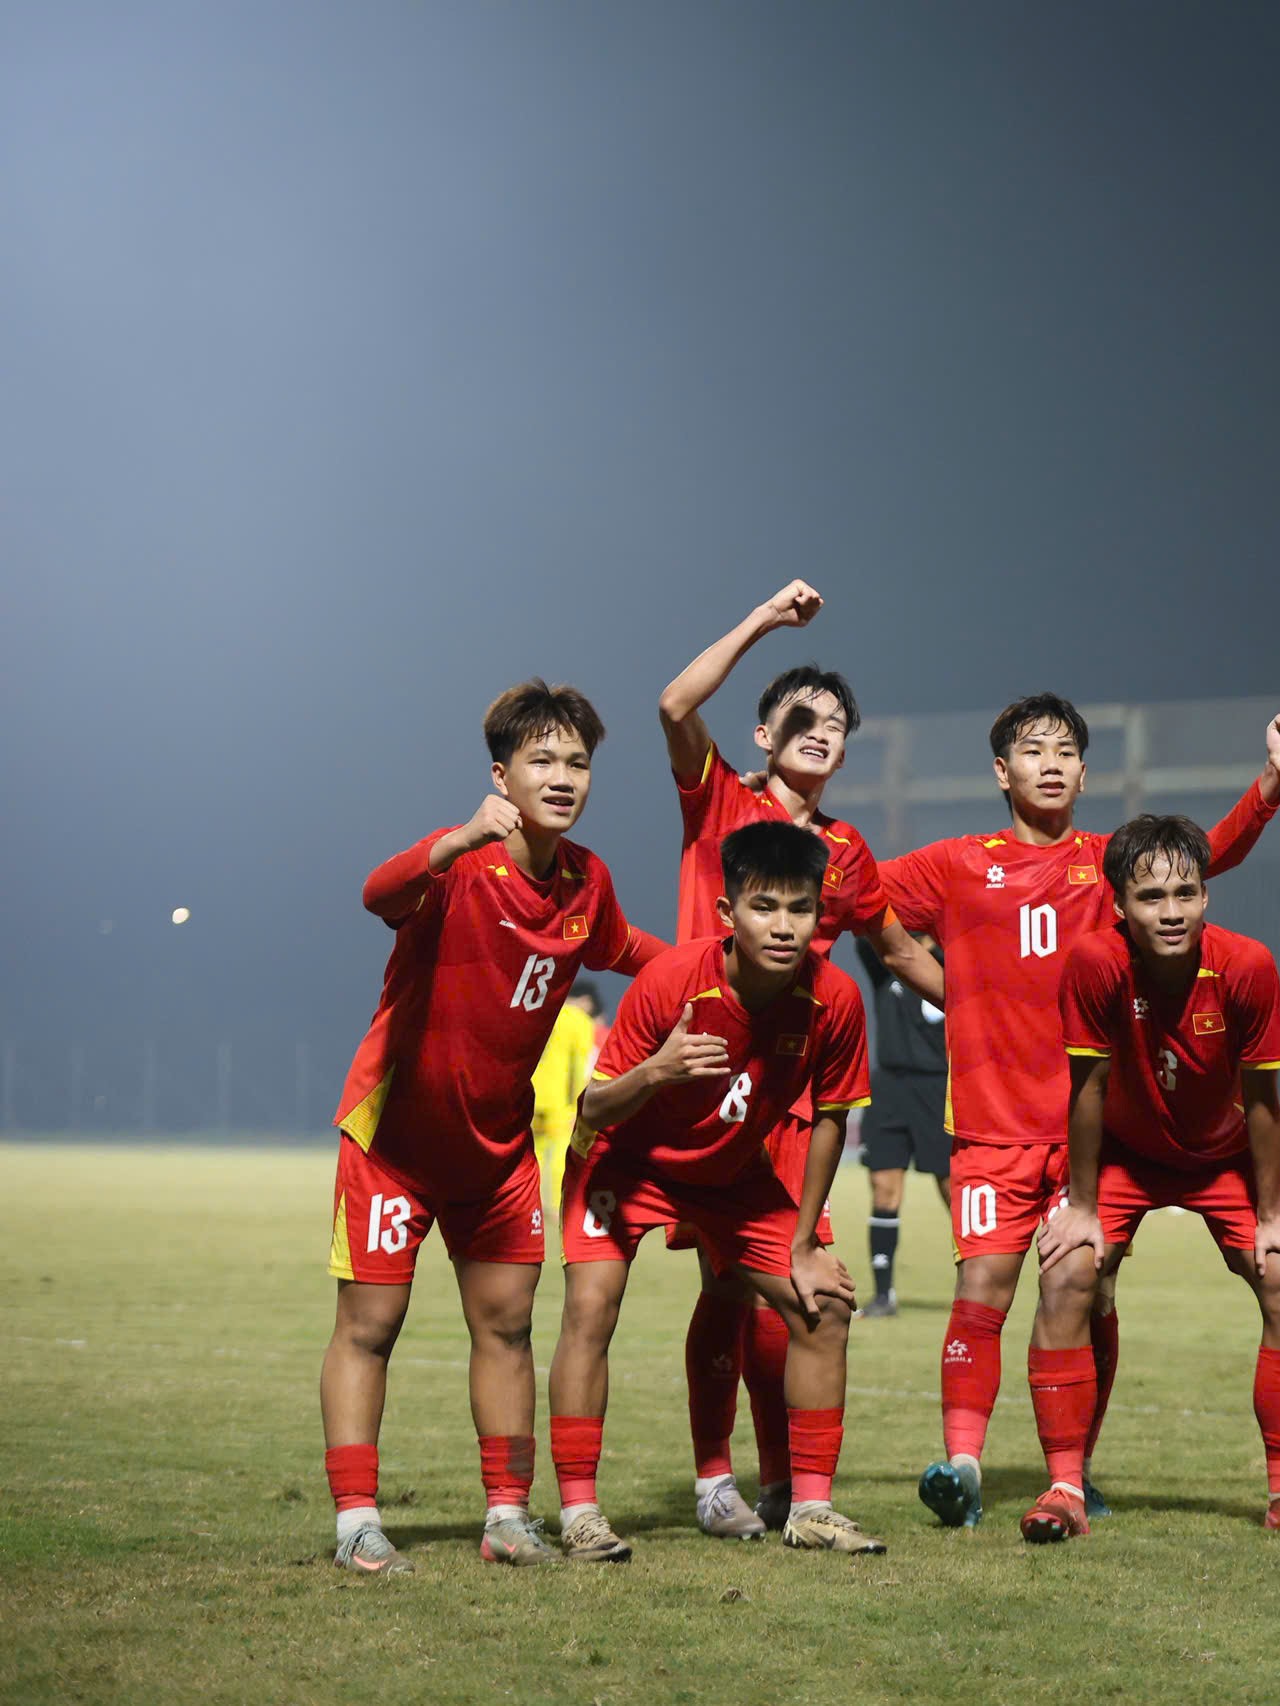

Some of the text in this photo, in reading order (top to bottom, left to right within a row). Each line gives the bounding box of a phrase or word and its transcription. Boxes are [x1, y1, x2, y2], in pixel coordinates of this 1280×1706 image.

[1019, 903, 1057, 959] 10
[509, 953, 556, 1012] 13
[719, 1071, 753, 1124] 8
[1155, 1048, 1178, 1091] 3
[366, 1192, 412, 1256] 13
[582, 1190, 617, 1239] 8
[961, 1183, 998, 1240] 10
